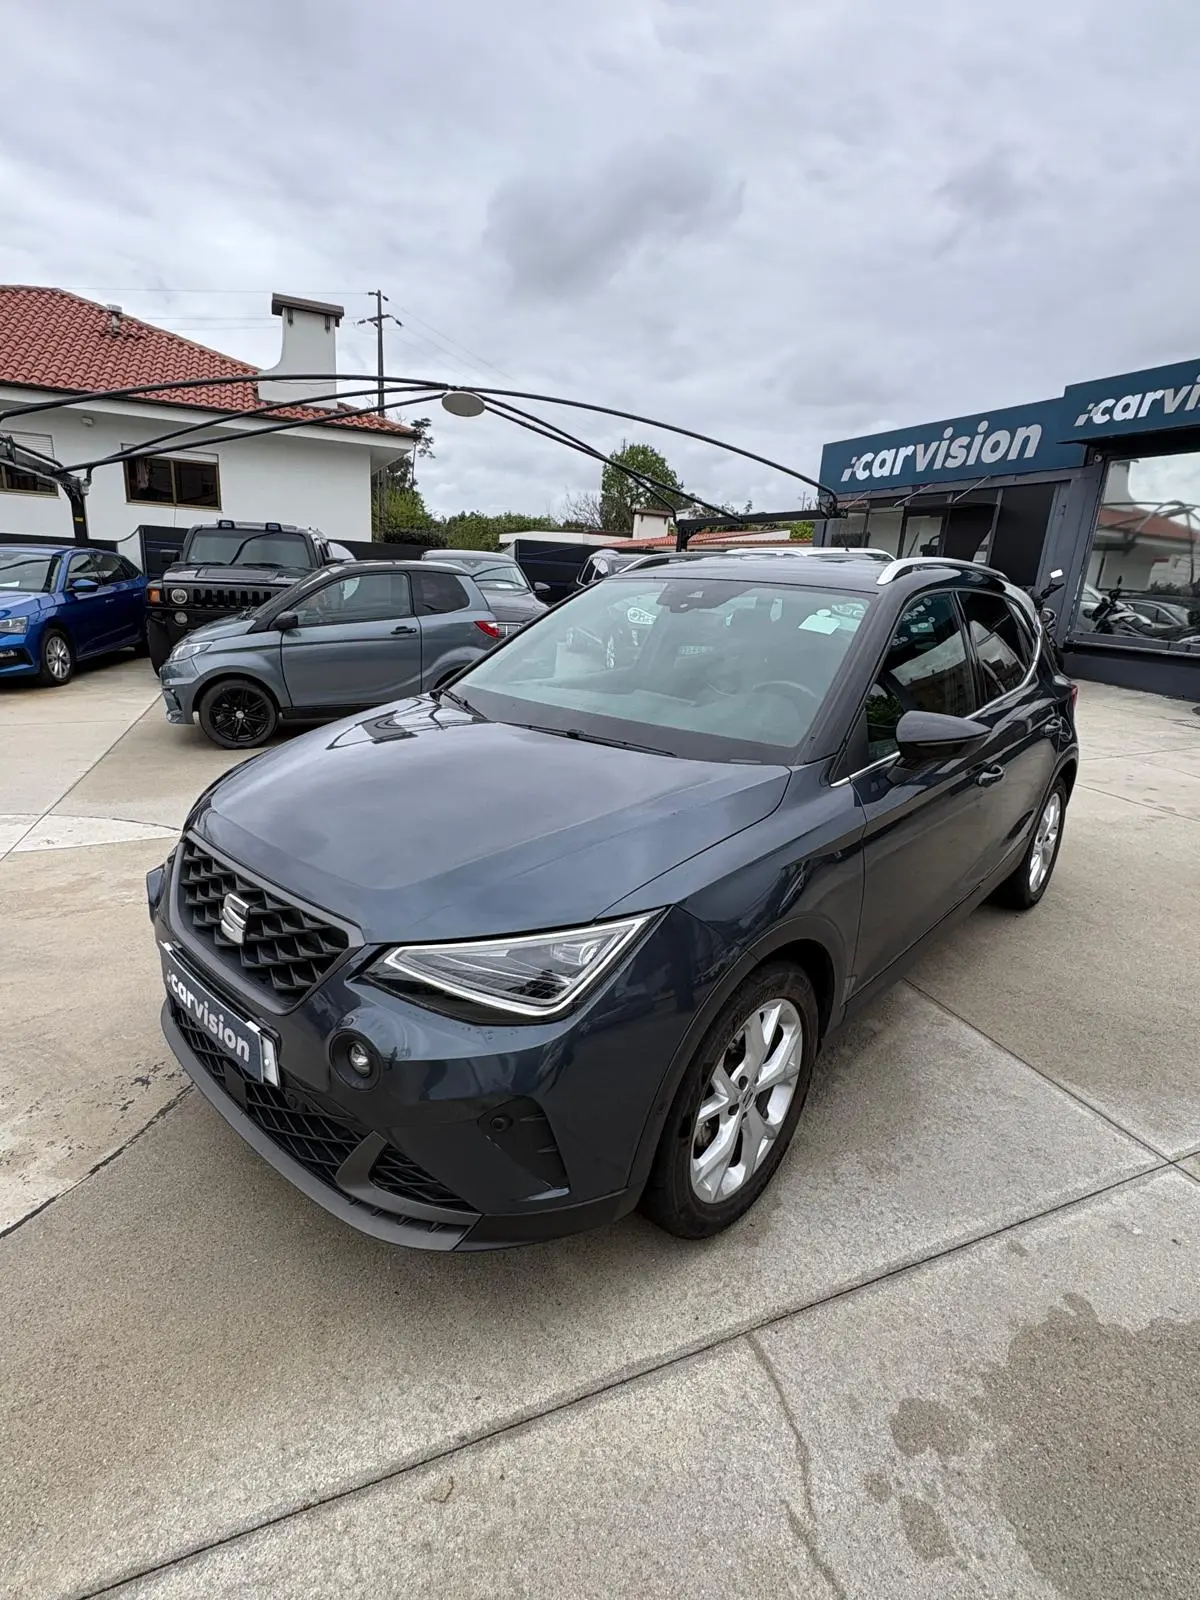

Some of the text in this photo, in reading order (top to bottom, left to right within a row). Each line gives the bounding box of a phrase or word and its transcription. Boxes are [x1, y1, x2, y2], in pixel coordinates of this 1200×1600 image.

[1092, 373, 1200, 424] carvi
[855, 420, 1042, 481] carvision
[170, 973, 250, 1063] carvision
